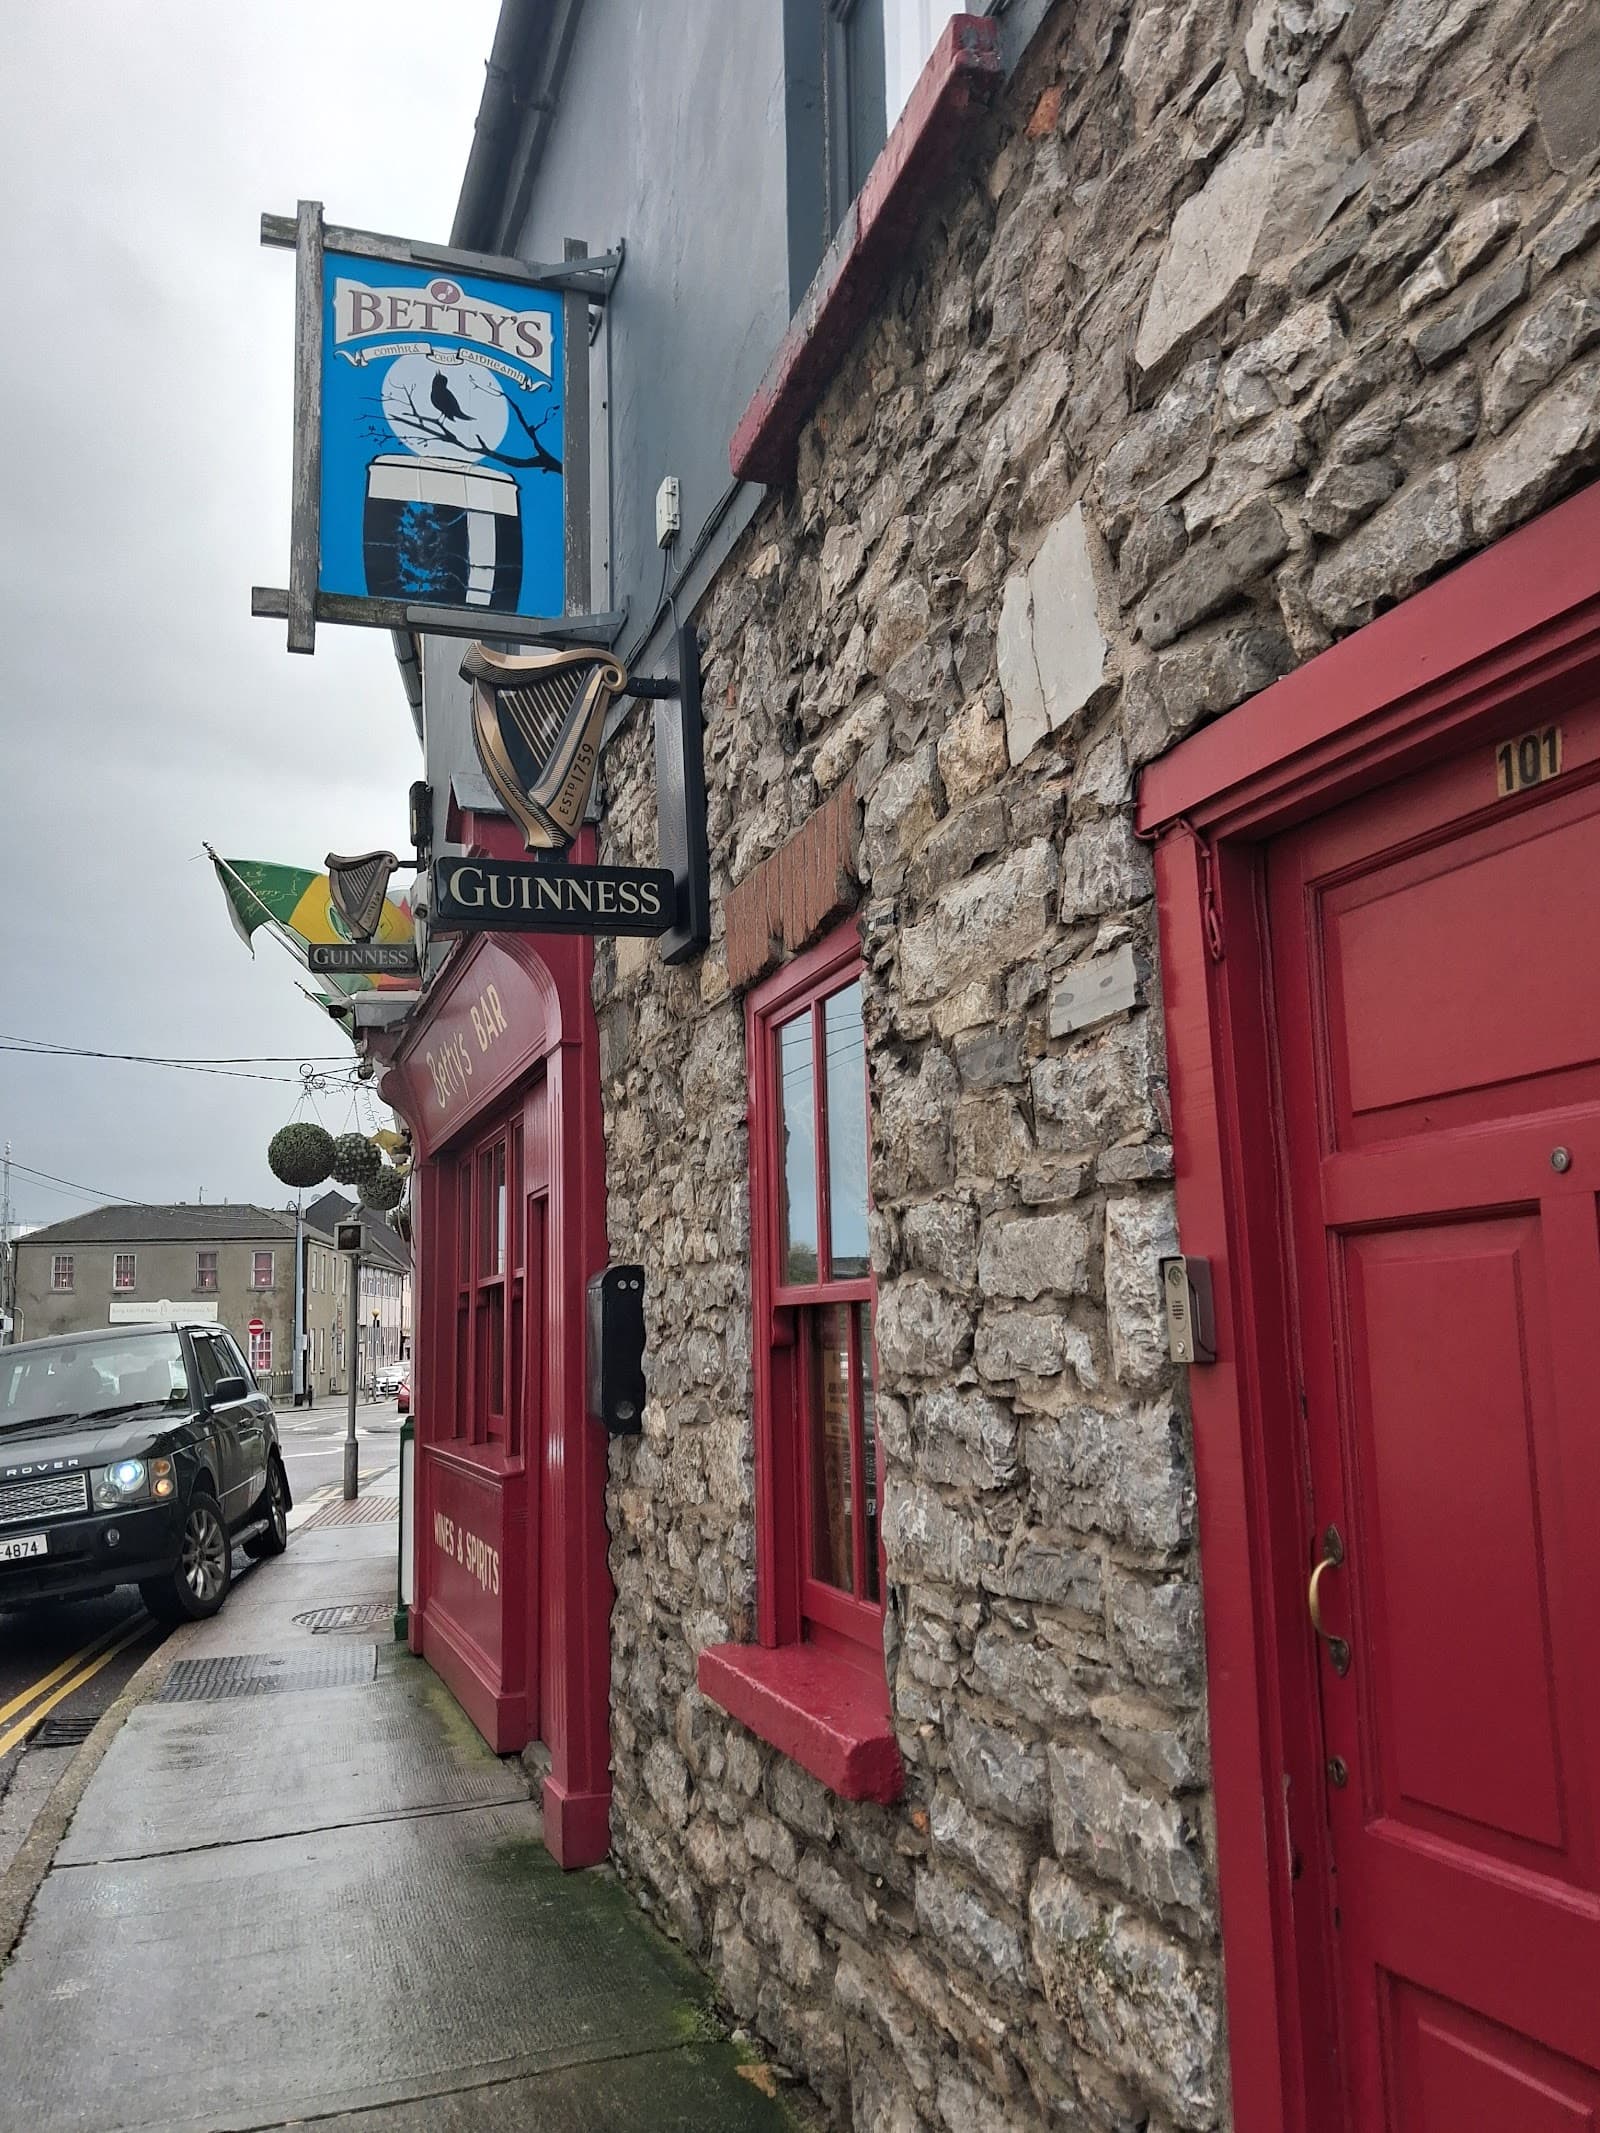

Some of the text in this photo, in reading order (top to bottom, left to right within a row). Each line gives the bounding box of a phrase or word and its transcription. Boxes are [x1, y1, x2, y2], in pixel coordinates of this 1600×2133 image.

[347, 289, 544, 359] BETTY'S
[571, 743, 595, 783] 1759
[1498, 725, 1558, 791] 101
[449, 866, 661, 915] GUINNESS
[313, 946, 409, 965] GUINNESS
[425, 983, 508, 1108] Betty's BAR
[6, 1459, 79, 1477] ROVER
[433, 1509, 500, 1596] WINES & SPIRITS
